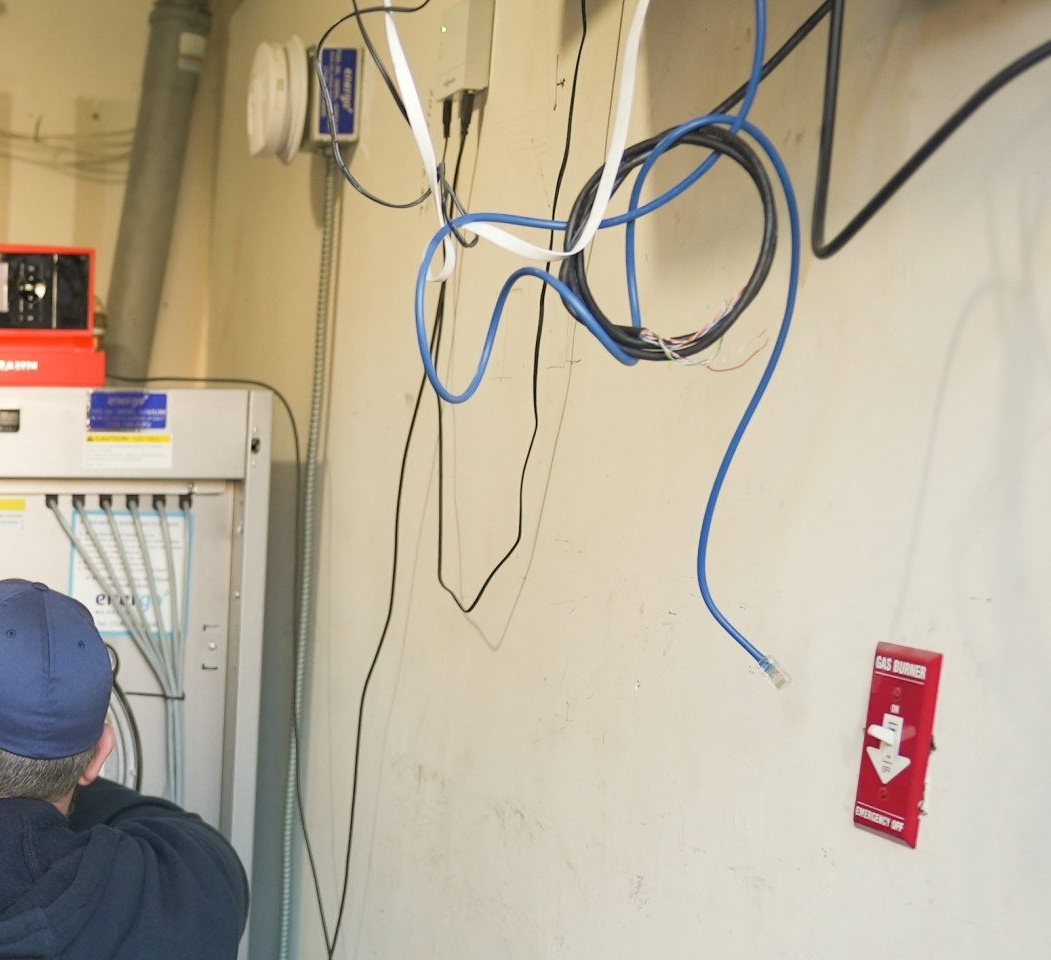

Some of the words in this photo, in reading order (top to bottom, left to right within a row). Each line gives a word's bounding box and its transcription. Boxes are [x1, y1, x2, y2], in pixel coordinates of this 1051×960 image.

[875, 655, 893, 672] GAS
[892, 659, 927, 680] BURNER
[890, 703, 901, 714] ON
[882, 765, 891, 774] OFF
[855, 806, 891, 828] EMERGENCY
[891, 819, 905, 833] OFF
